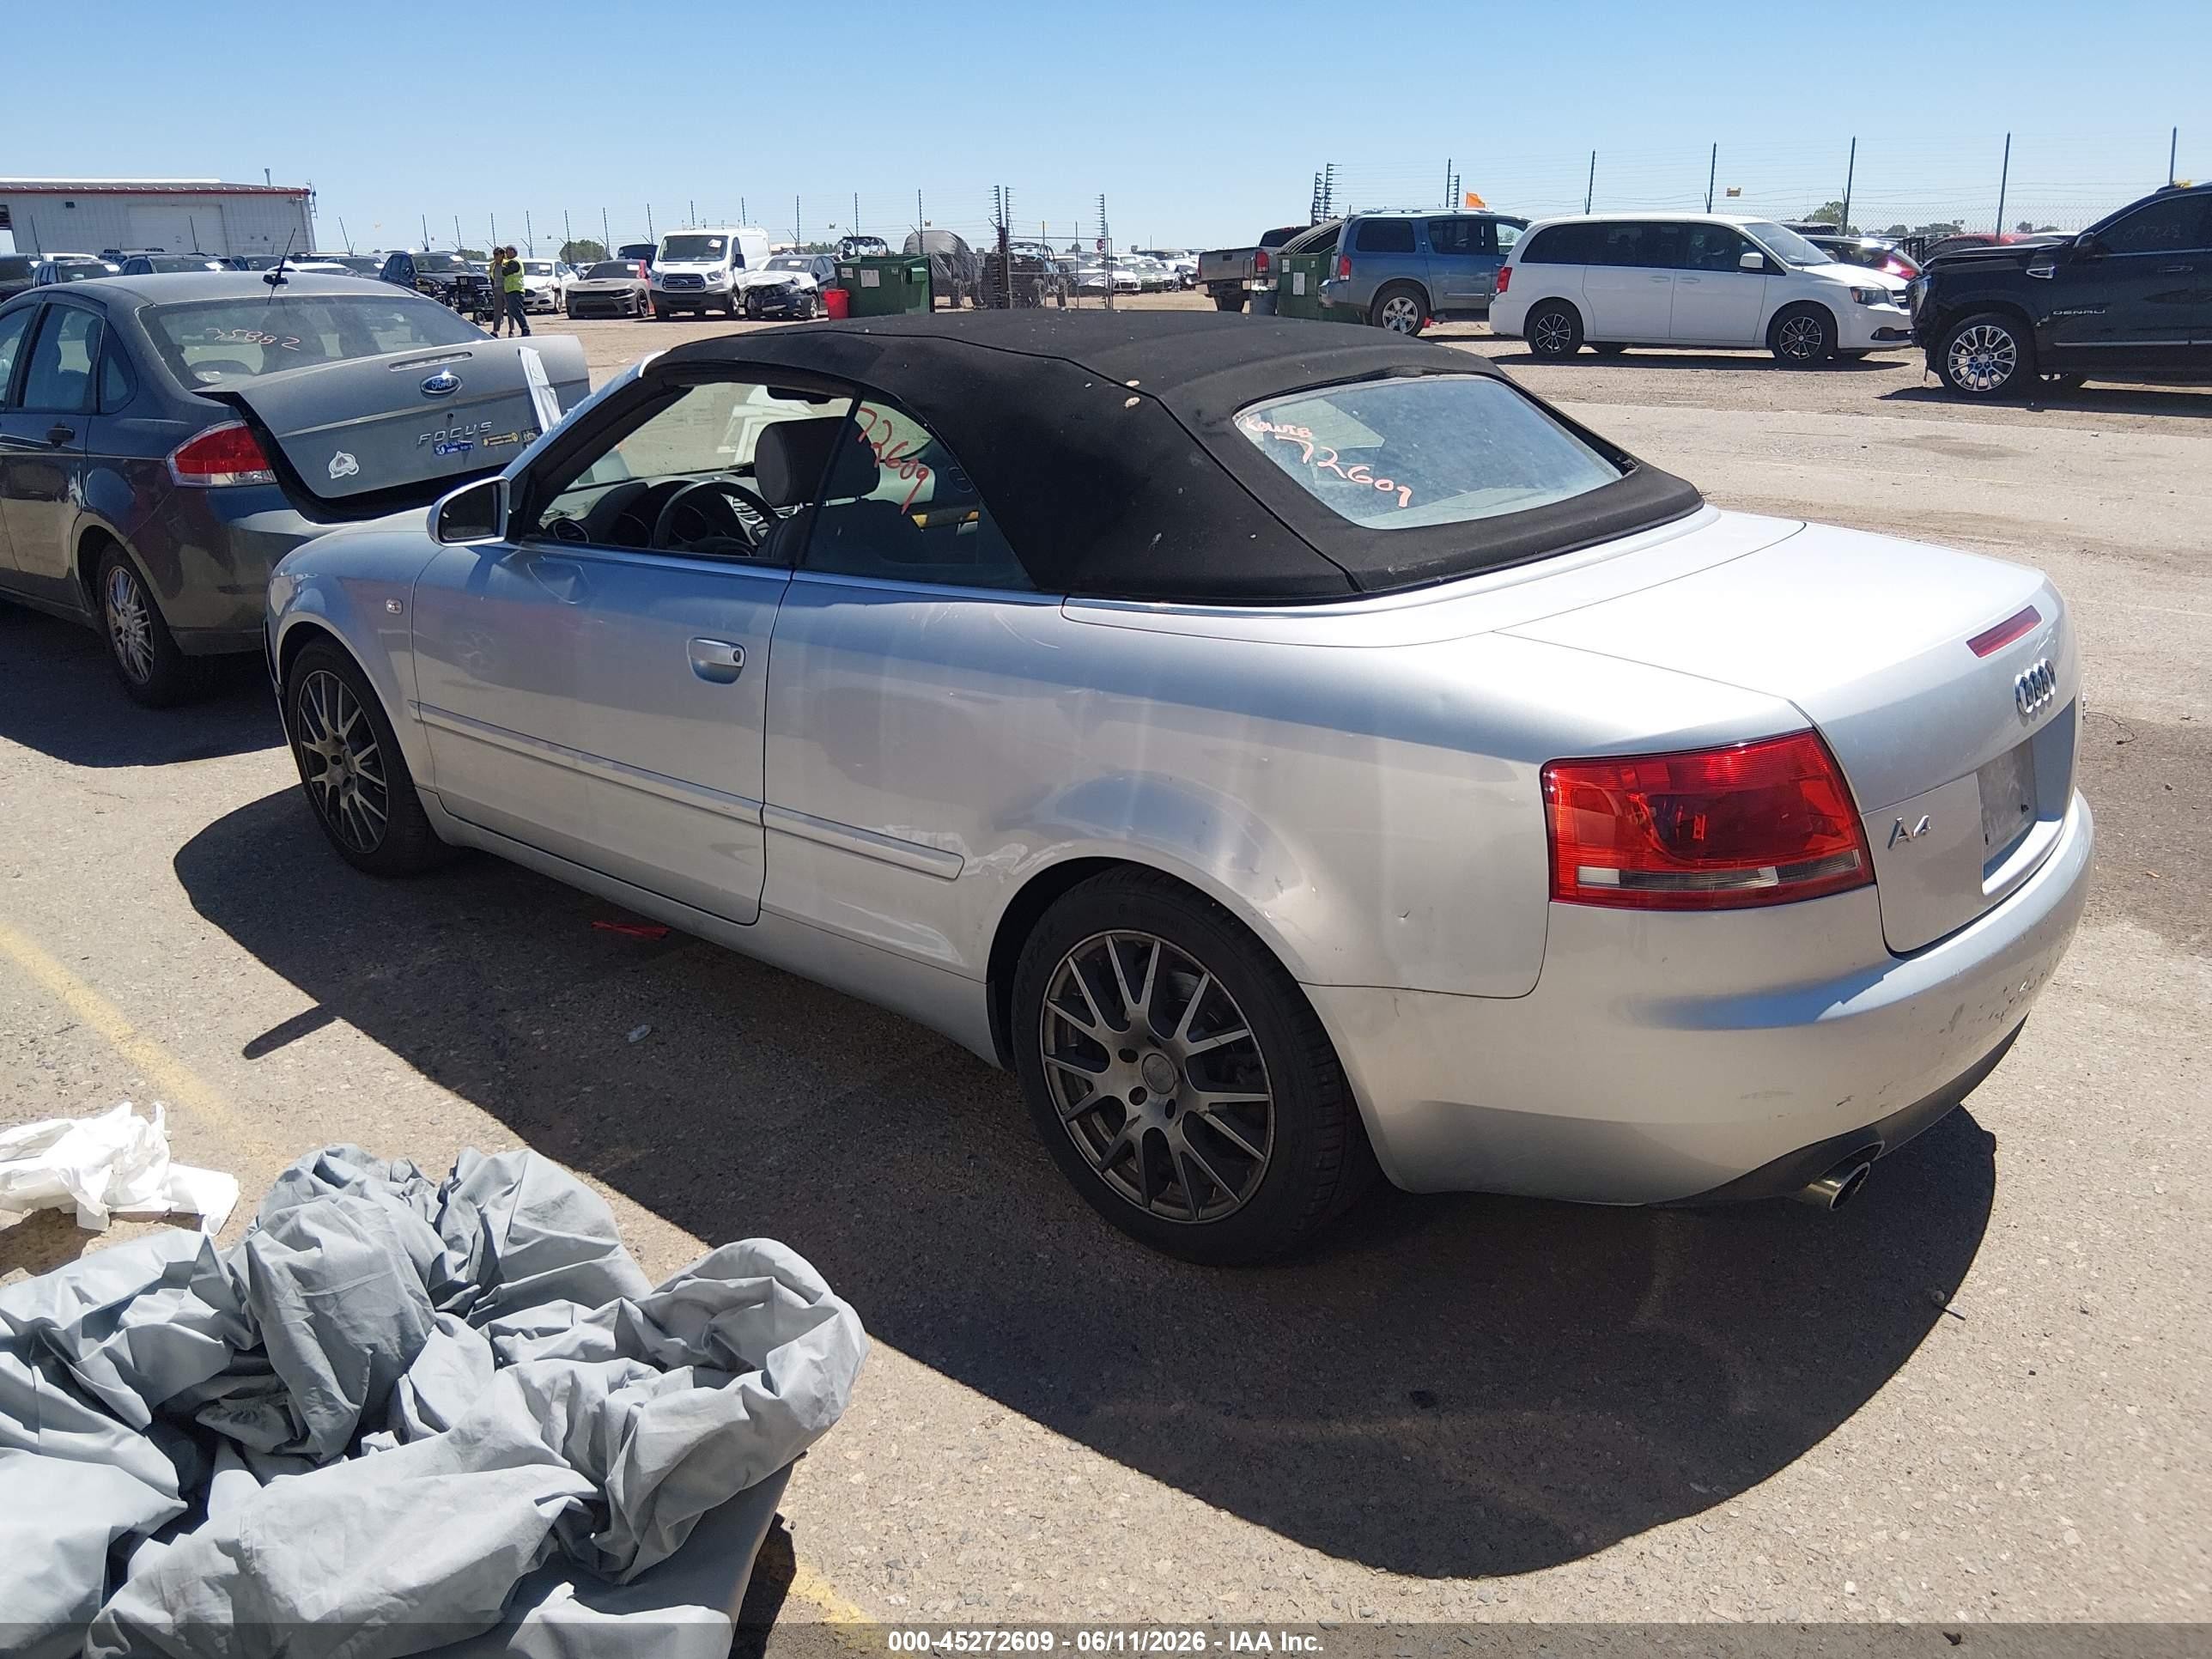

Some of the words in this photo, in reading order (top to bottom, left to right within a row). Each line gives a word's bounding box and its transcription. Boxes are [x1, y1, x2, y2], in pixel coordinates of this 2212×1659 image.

[430, 378, 454, 391] Ford
[417, 421, 493, 446] FOCUS
[856, 406, 930, 515] 72609
[1887, 814, 1931, 850] A4
